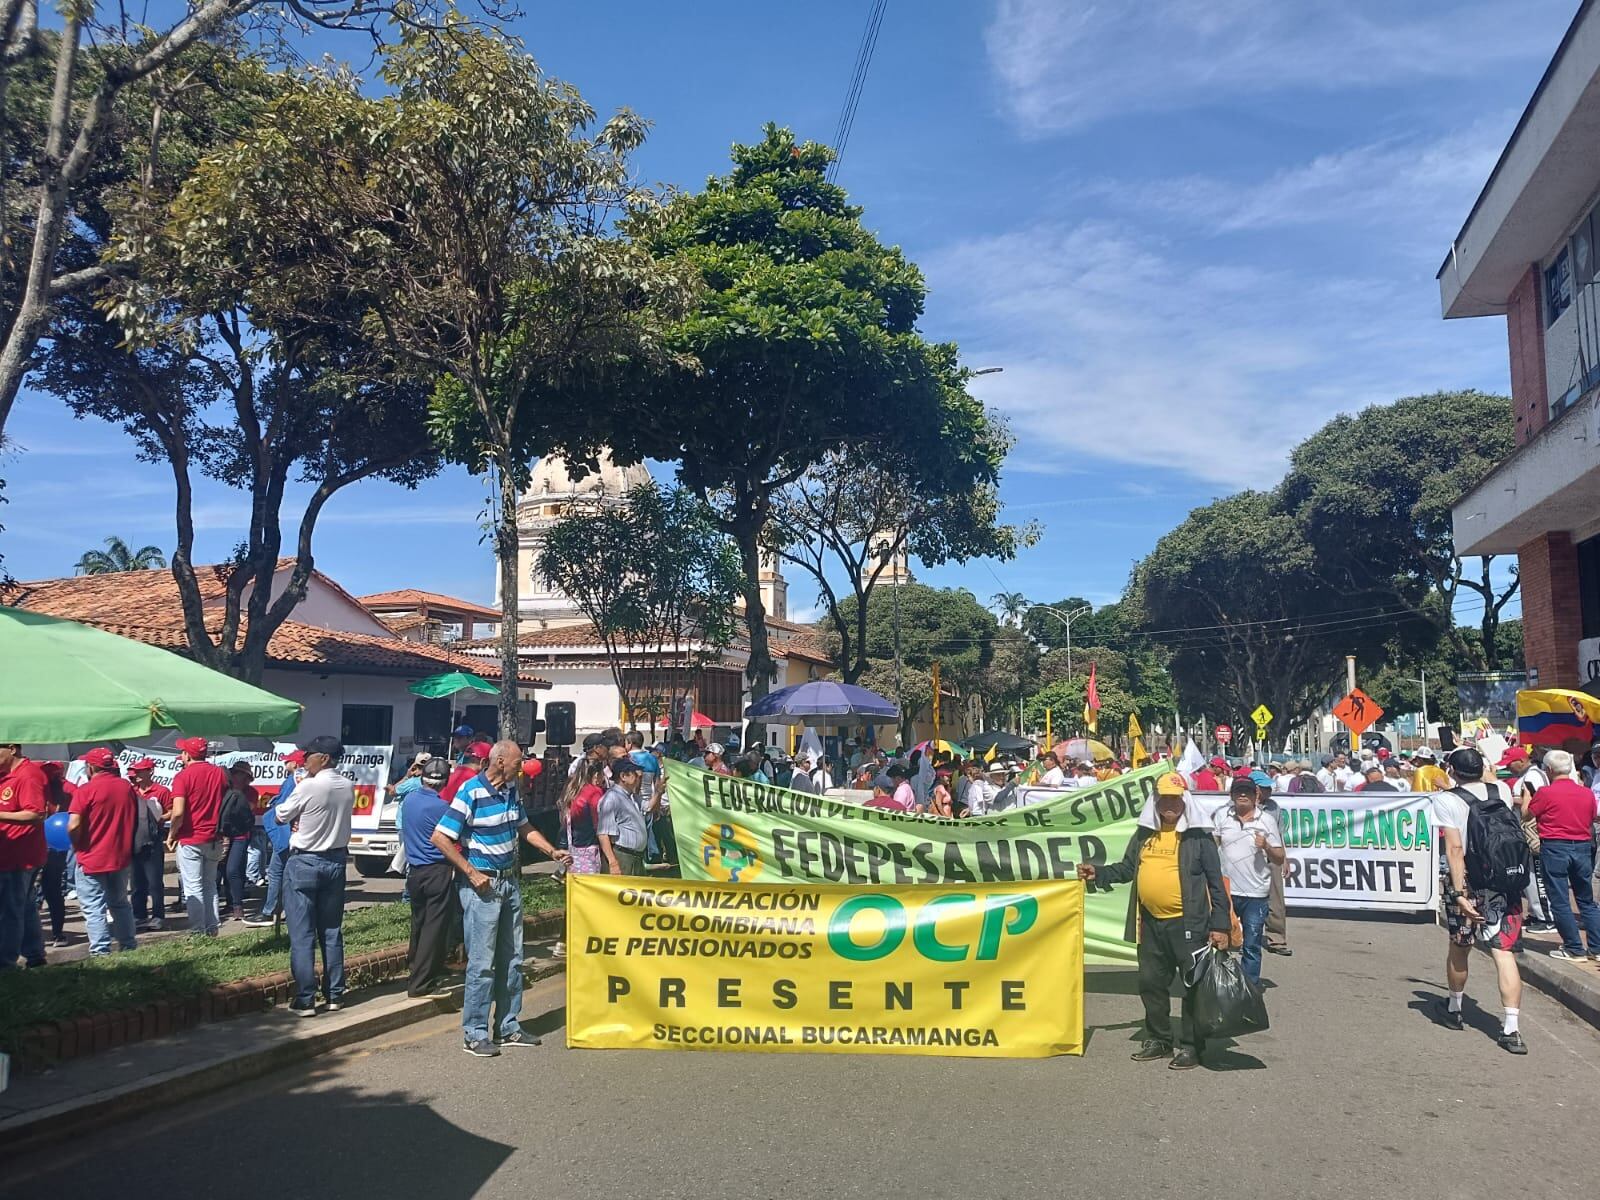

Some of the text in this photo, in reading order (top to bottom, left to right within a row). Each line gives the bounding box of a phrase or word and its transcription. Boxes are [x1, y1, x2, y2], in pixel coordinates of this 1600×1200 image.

[828, 802, 855, 819] DE
[1023, 808, 1055, 827] DE
[720, 823, 735, 841] D
[1280, 807, 1431, 852] RIDABLANCA
[703, 845, 716, 867] F
[771, 828, 1115, 894] FEDEPESANDER
[1284, 857, 1417, 893] RESENTE
[617, 888, 821, 911] ORGANIZACIÓN
[639, 913, 816, 936] COLOMBIANA
[827, 892, 1039, 963] OCP
[585, 936, 813, 960] DE PENSIONADOS
[653, 1023, 999, 1047] SECCIONAL BUCARAMANGA
